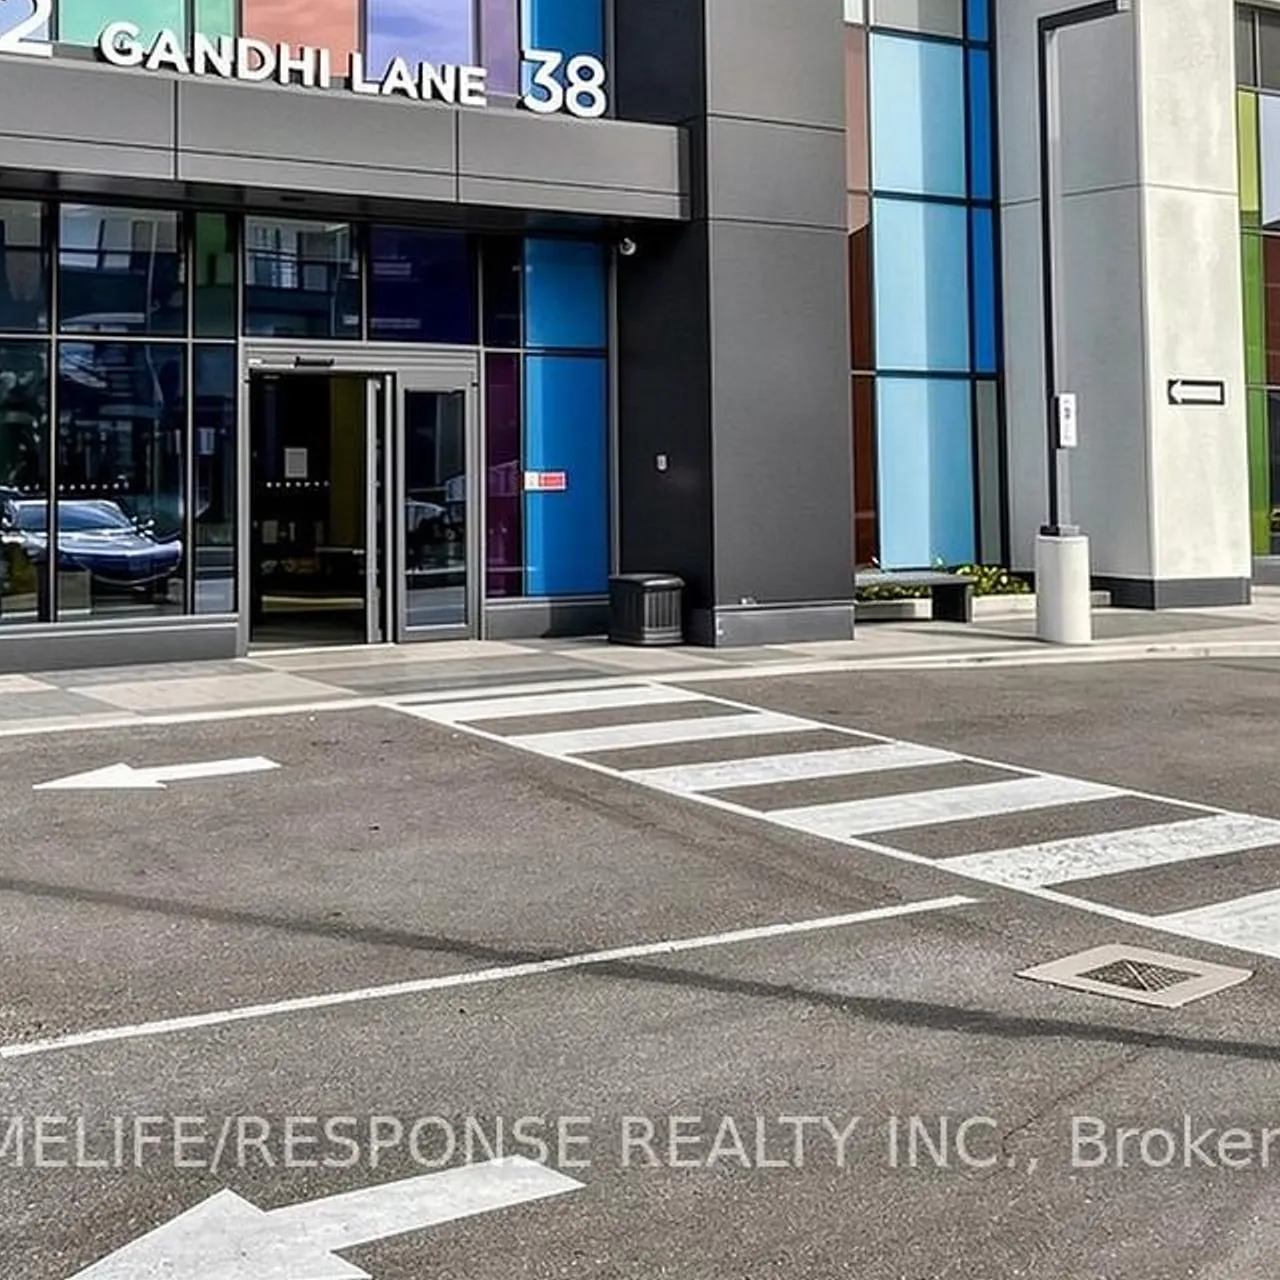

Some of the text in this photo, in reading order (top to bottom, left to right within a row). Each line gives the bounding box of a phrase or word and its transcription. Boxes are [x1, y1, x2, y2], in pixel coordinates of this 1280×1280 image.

[98, 20, 331, 89] GANDHI
[349, 51, 488, 108] LANE
[519, 48, 608, 119] 38
